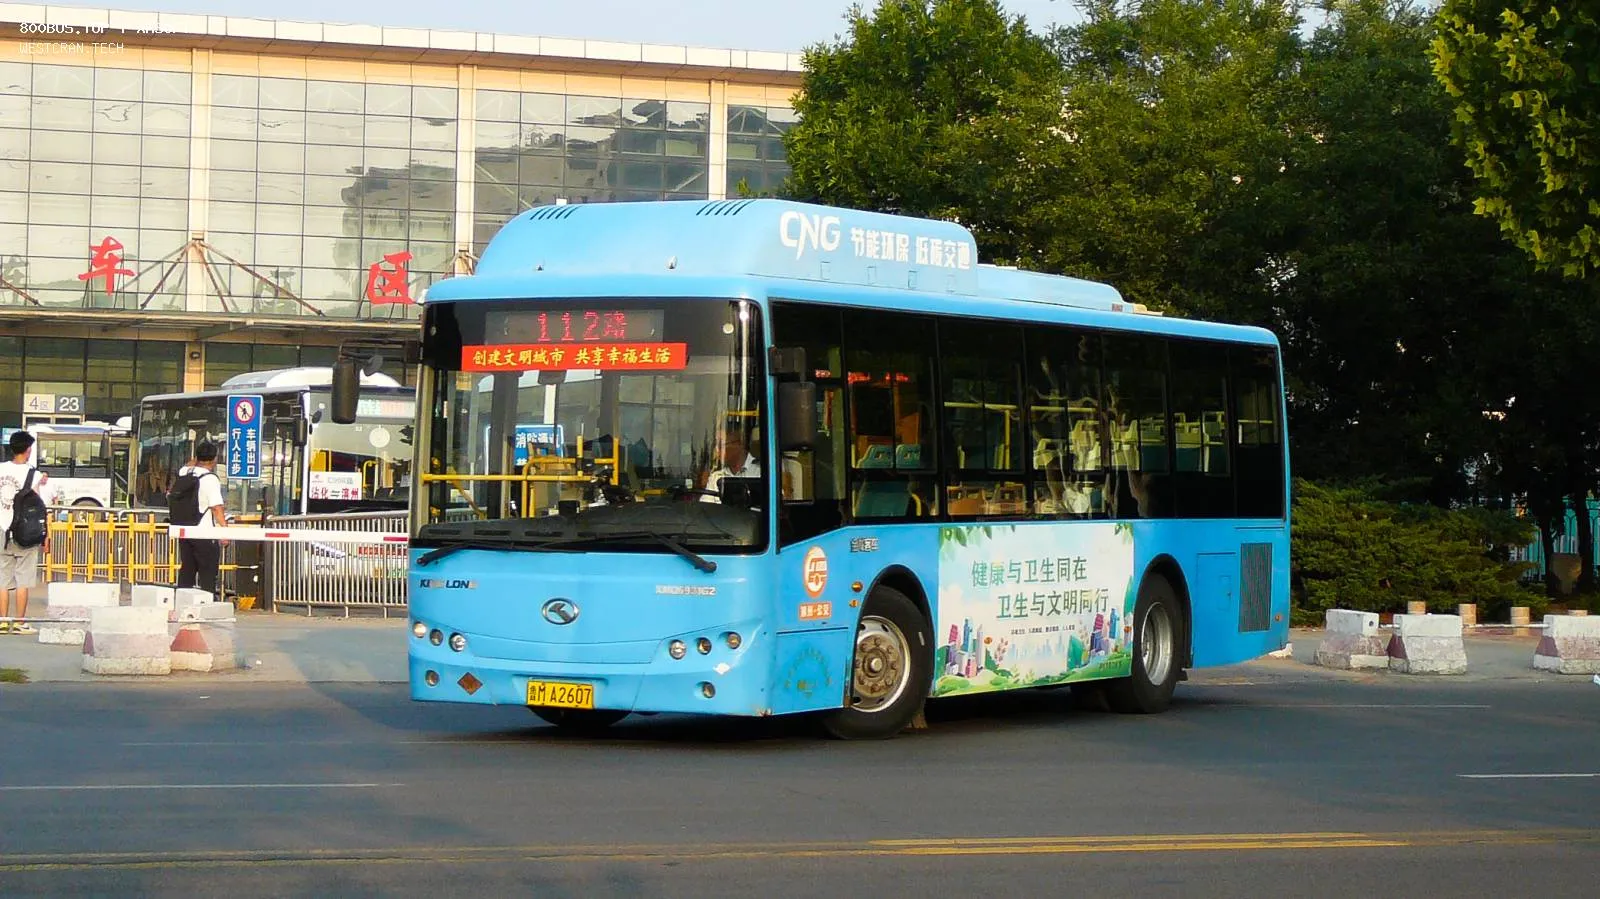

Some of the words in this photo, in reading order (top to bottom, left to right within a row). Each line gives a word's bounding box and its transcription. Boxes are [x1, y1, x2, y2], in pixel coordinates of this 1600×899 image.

[779, 210, 841, 260] CNG
[850, 226, 910, 263] 节能环保
[472, 347, 565, 367] 创建文明城市
[573, 346, 672, 366] 共享幸福生活
[58, 396, 80, 411] 23
[231, 427, 242, 475] 行人止步
[246, 427, 257, 475] 车辆出口
[971, 555, 1088, 588] 健康与卫生同在
[995, 588, 1109, 620] 卫生与文明同行
